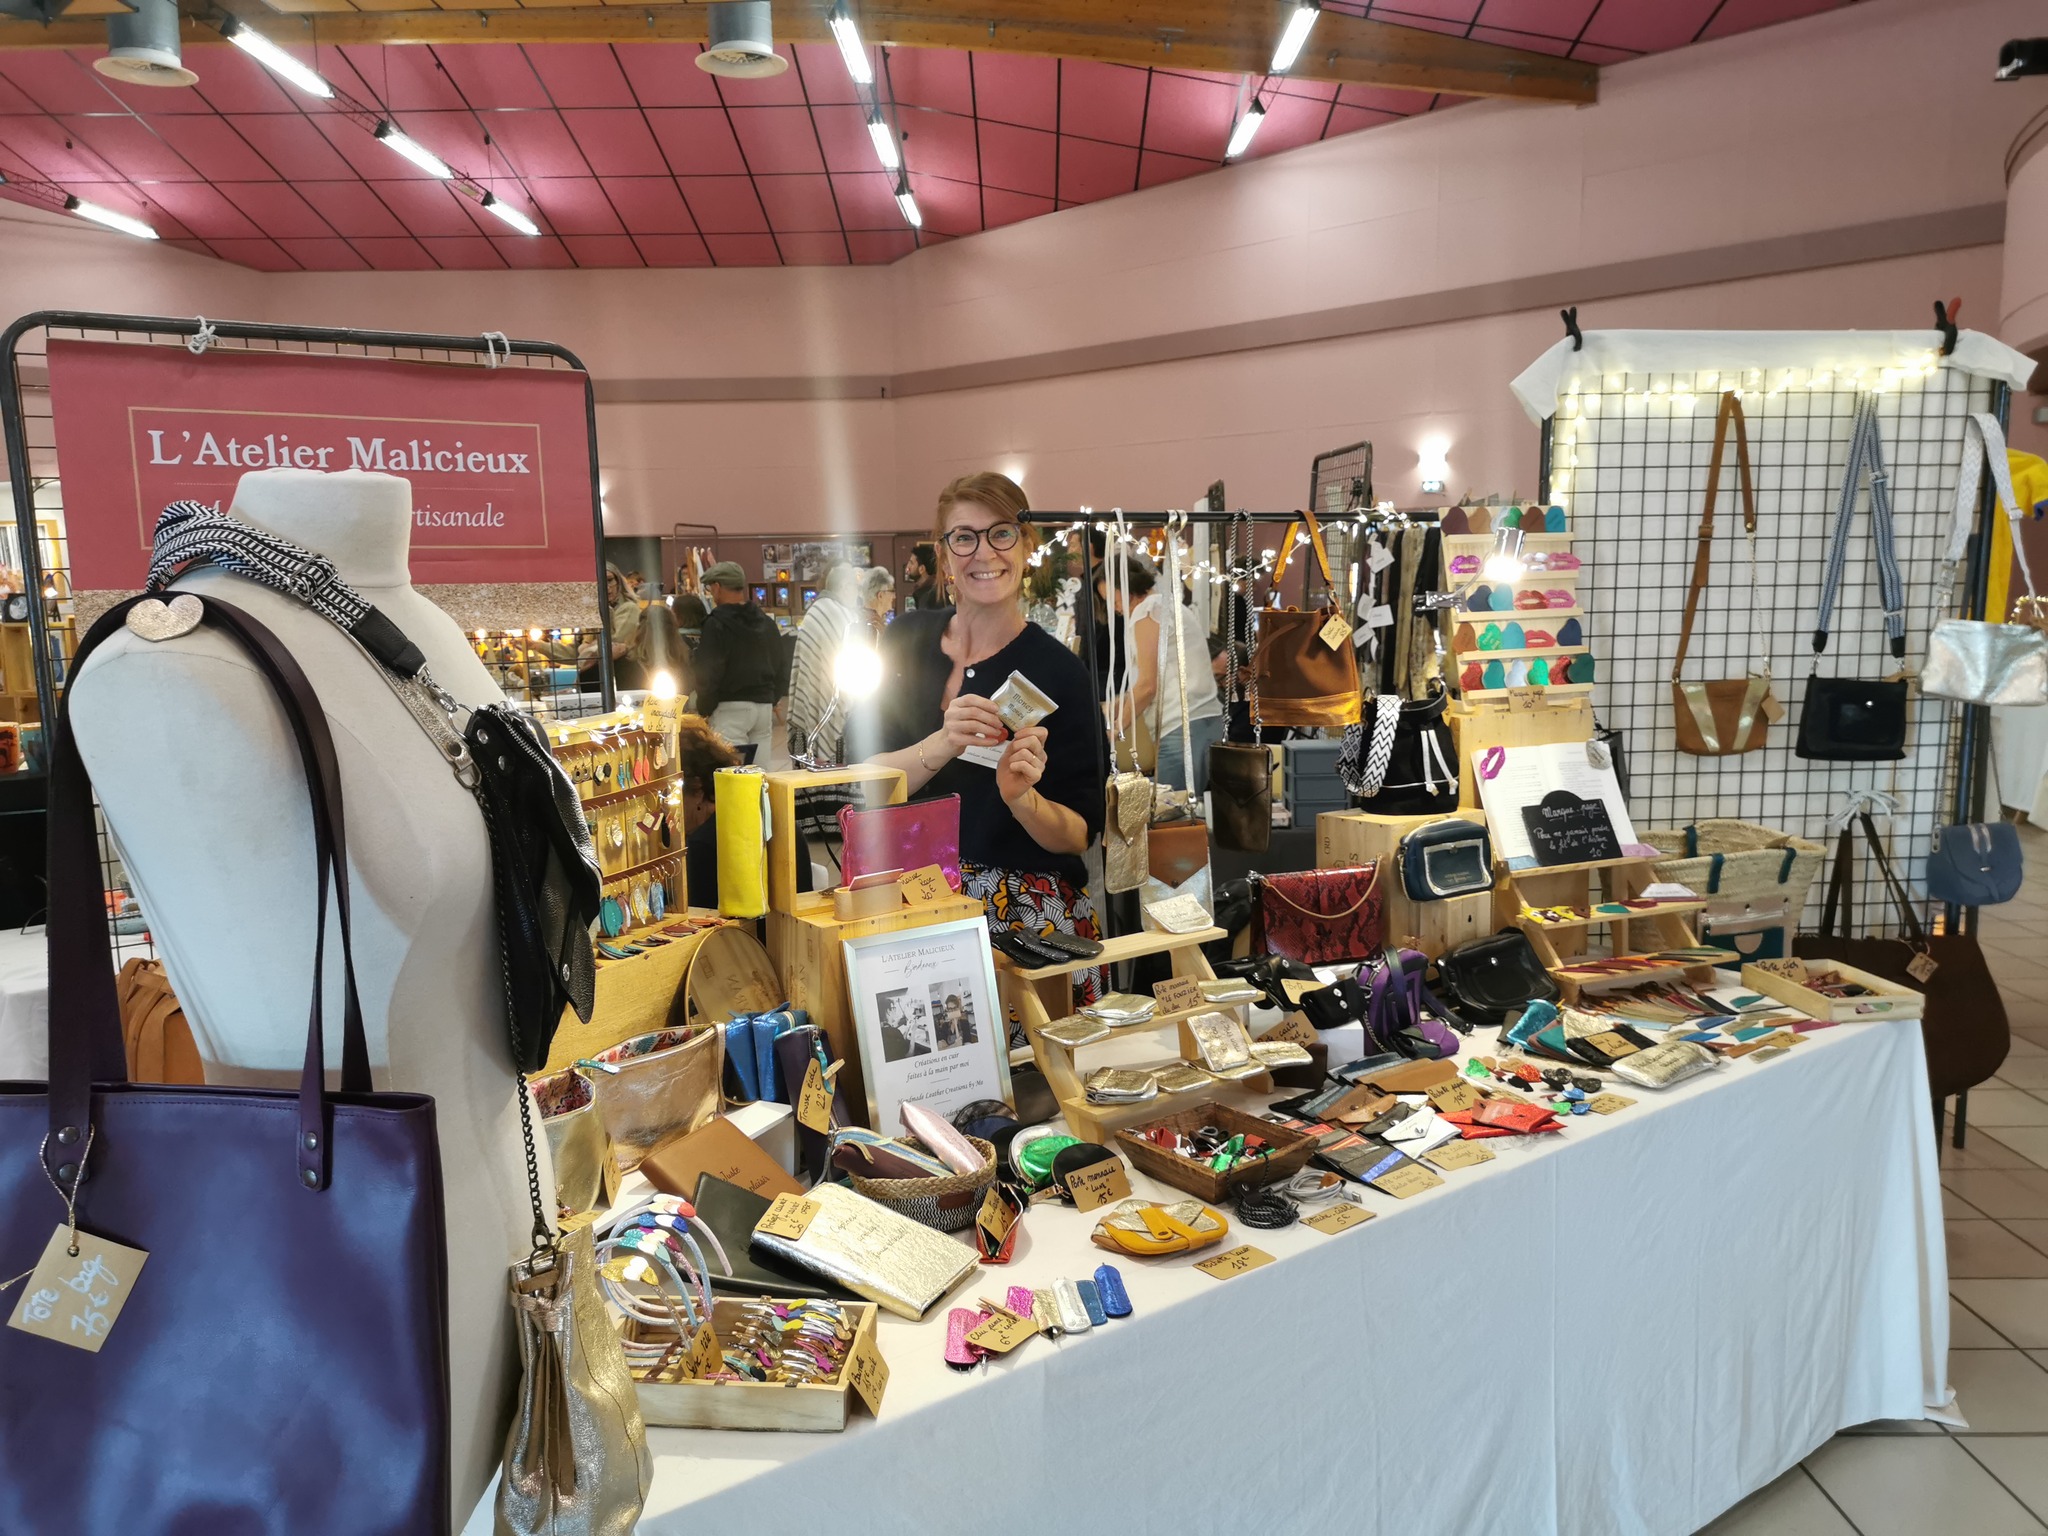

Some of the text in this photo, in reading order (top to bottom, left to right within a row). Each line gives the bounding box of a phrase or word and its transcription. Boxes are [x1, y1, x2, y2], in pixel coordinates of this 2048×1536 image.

[147, 429, 531, 474] L'Atelier Malicieux
[411, 502, 505, 527] tisanale
[1012, 693, 1035, 714] Money
[917, 944, 956, 957] MALICIEUX
[914, 1052, 960, 1069] Créations en cuir
[906, 1072, 923, 1084] faites
[928, 1067, 934, 1076] la
[935, 1066, 949, 1074] main
[949, 1063, 959, 1073] par
[959, 1060, 970, 1068] moi
[925, 1089, 945, 1100] Leather
[945, 1082, 969, 1095] Creations
[968, 1080, 976, 1090] by
[1069, 1174, 1085, 1189] Porte
[1097, 1187, 1114, 1206] 15€
[58, 1254, 119, 1294] bag
[22, 1288, 60, 1325] Tote
